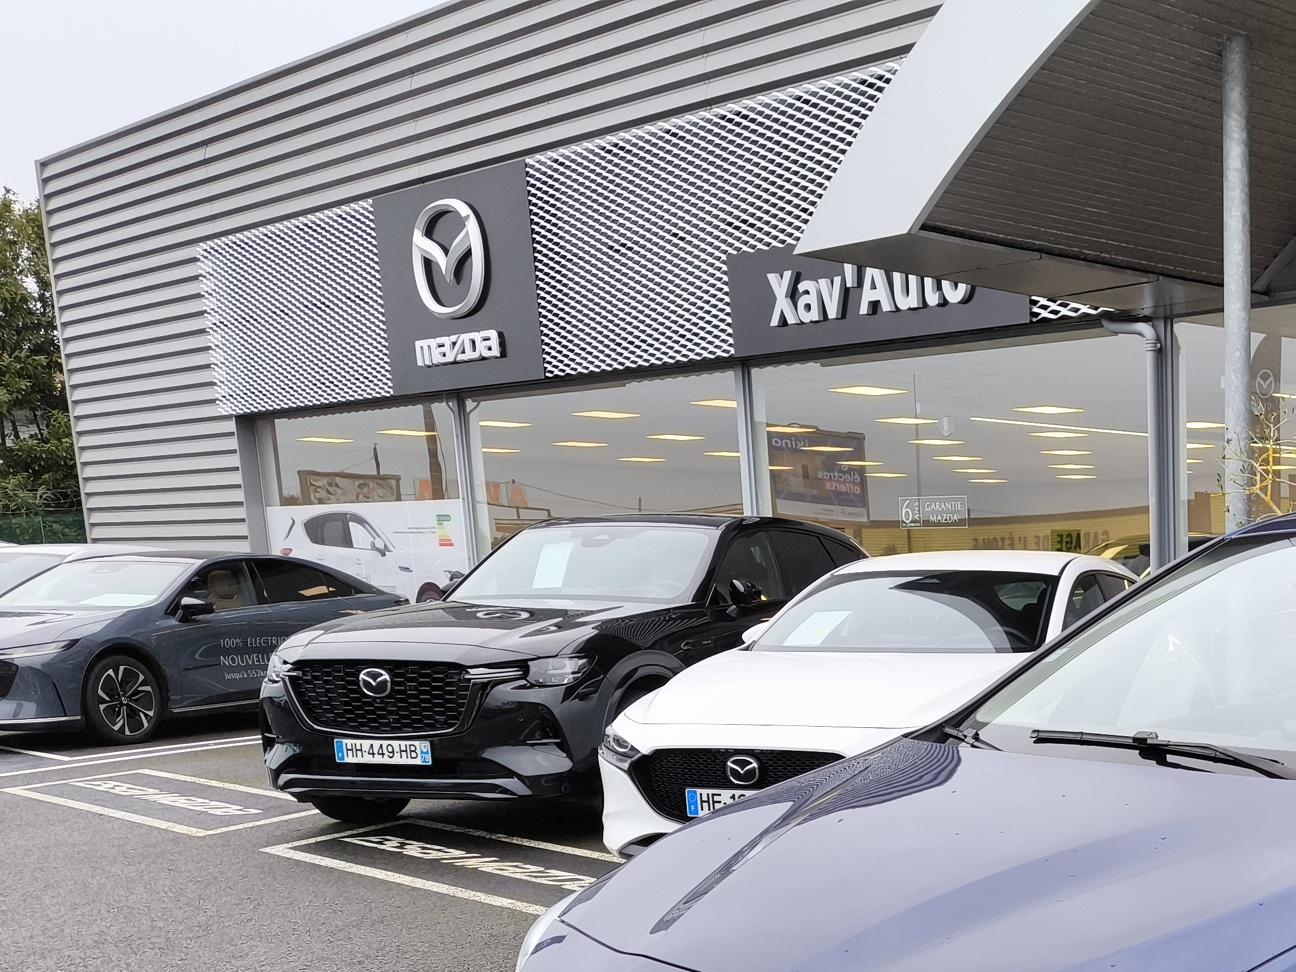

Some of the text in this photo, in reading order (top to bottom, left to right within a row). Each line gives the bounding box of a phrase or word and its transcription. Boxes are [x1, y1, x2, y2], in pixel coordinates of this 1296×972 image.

[902, 500, 912, 523] 6
[925, 501, 963, 511] GARANTIE
[929, 513, 959, 523] MAZDA
[220, 653, 273, 666] NOUVELL
[345, 743, 418, 760] HH-449-HB
